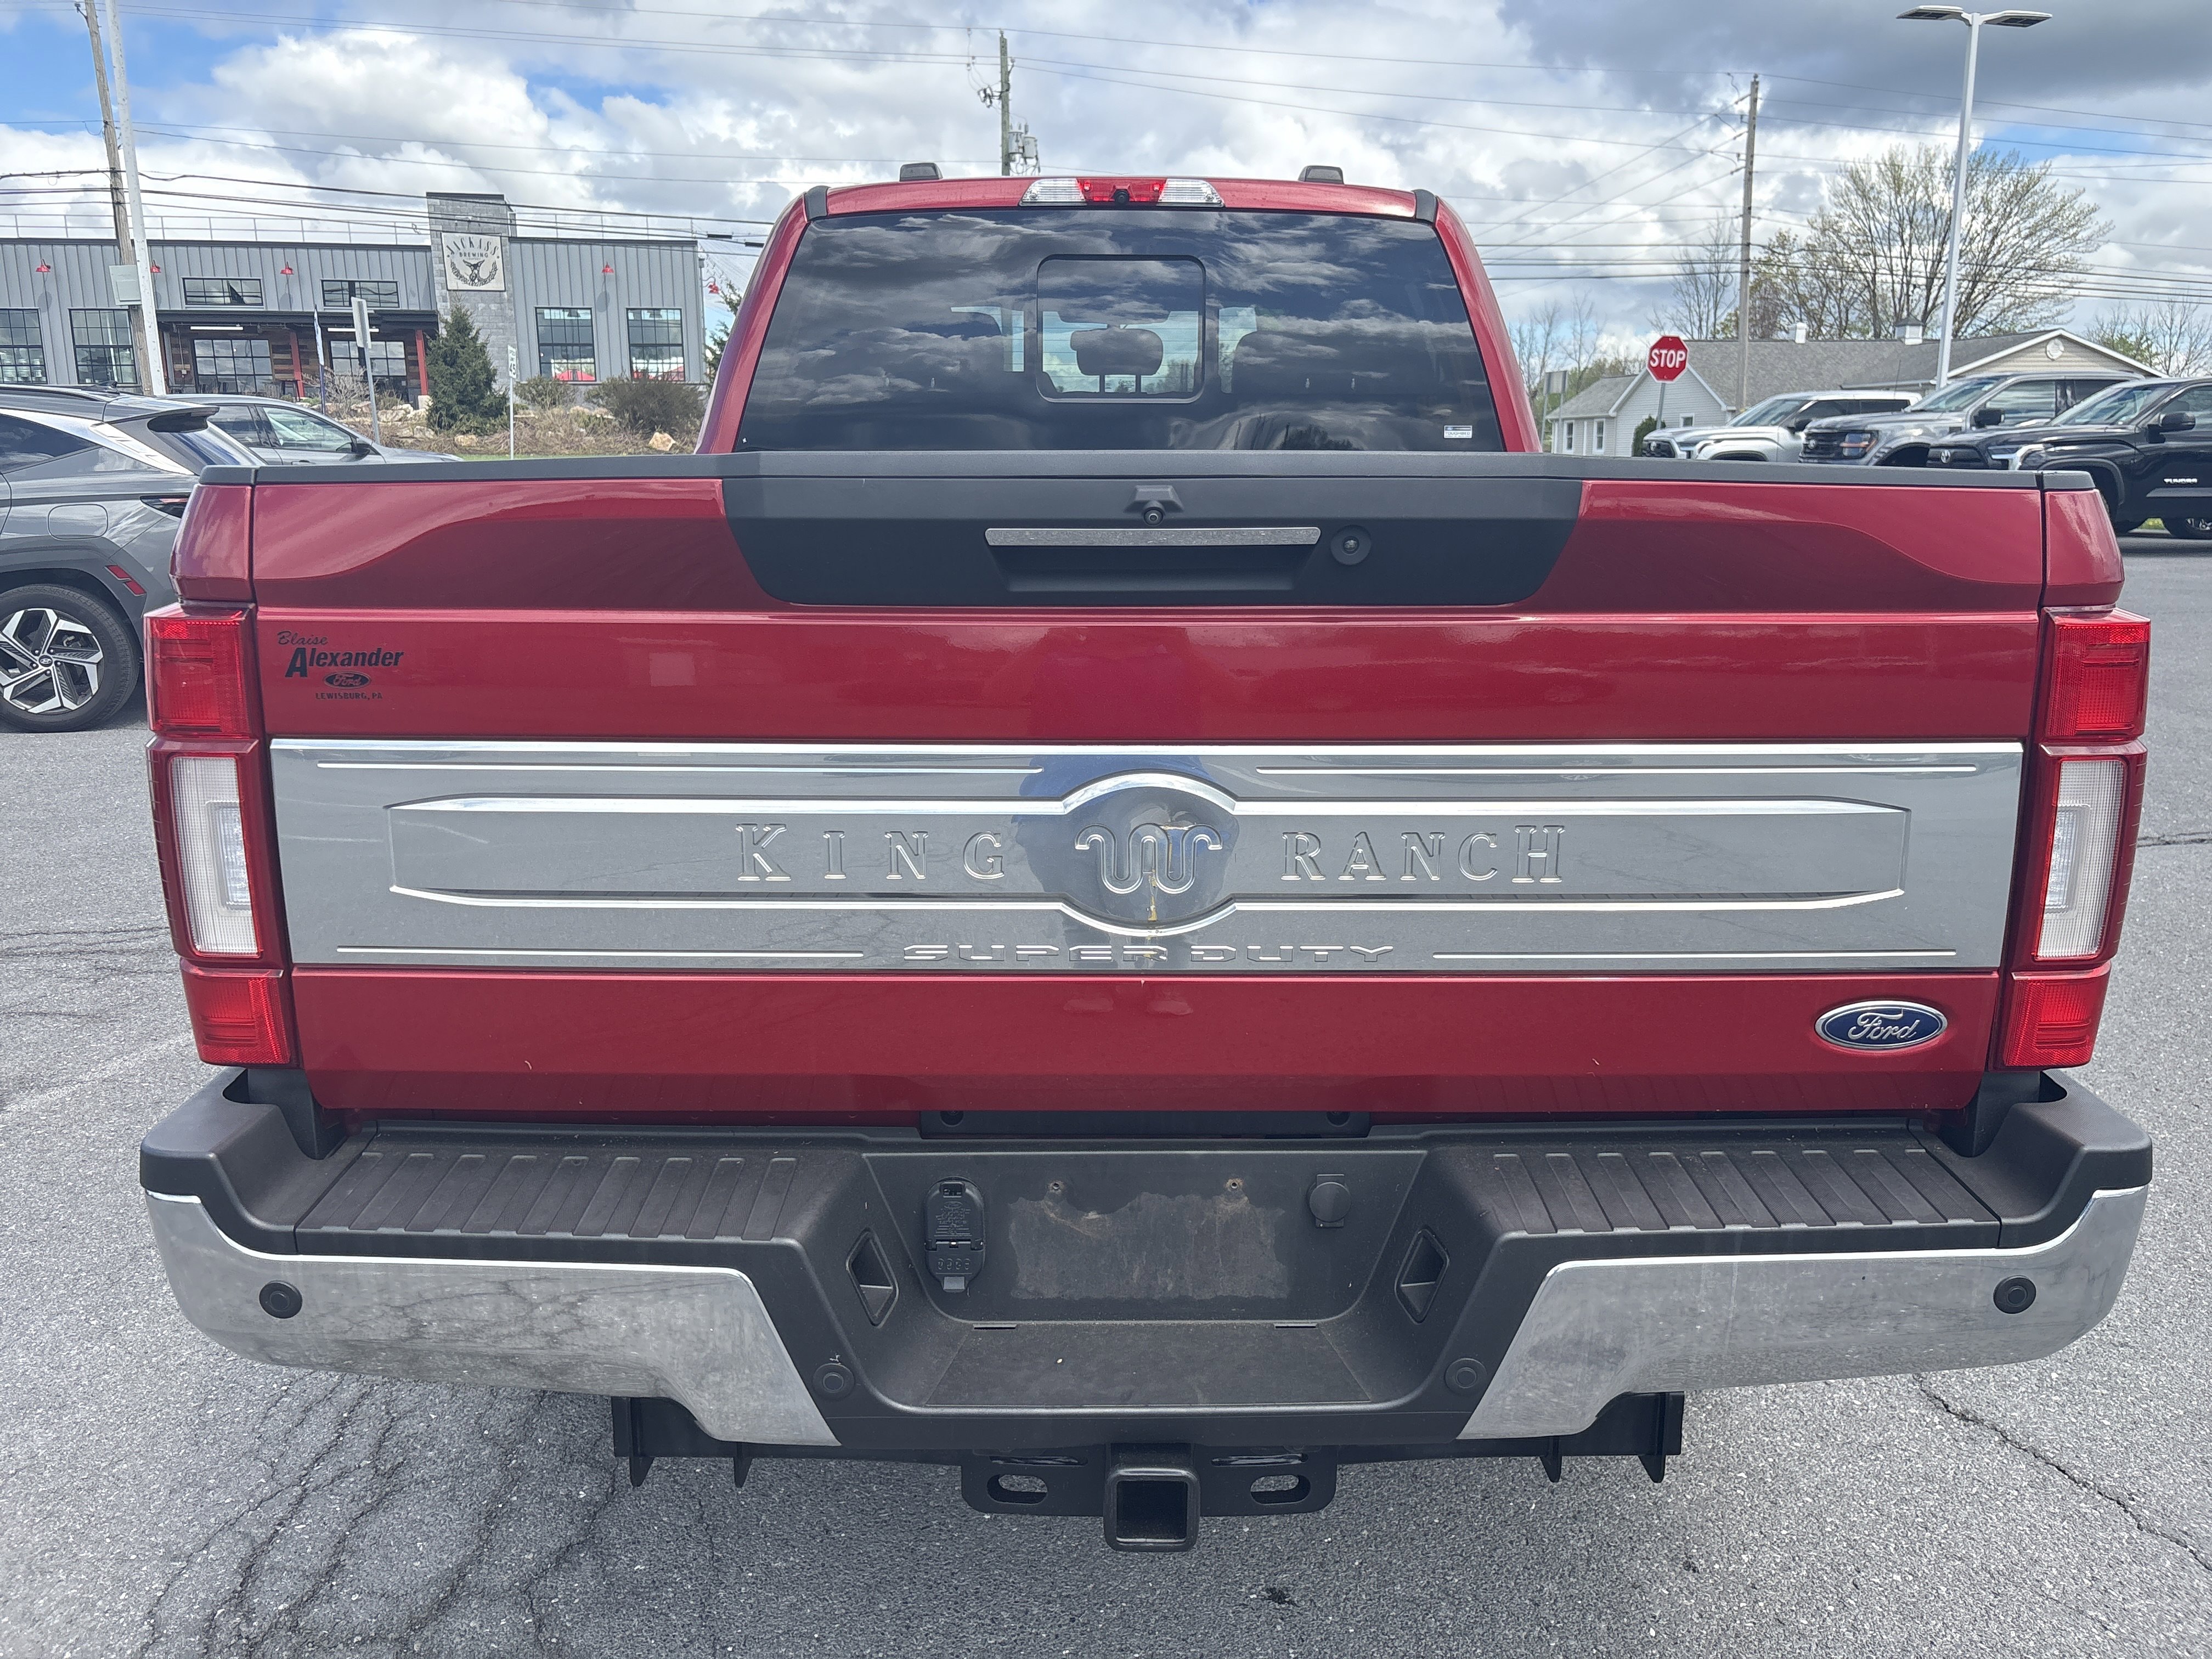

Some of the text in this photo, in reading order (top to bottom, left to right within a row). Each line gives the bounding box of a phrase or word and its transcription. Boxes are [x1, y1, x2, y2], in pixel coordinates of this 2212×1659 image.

[1650, 349, 1686, 368] STOP
[277, 630, 328, 645] Blaise
[285, 647, 404, 678] Alexander
[332, 673, 363, 686] Ford
[736, 823, 1566, 883] KING RANCH
[904, 944, 1393, 963] SUPER DUTY
[1847, 1007, 1920, 1040] Ford
